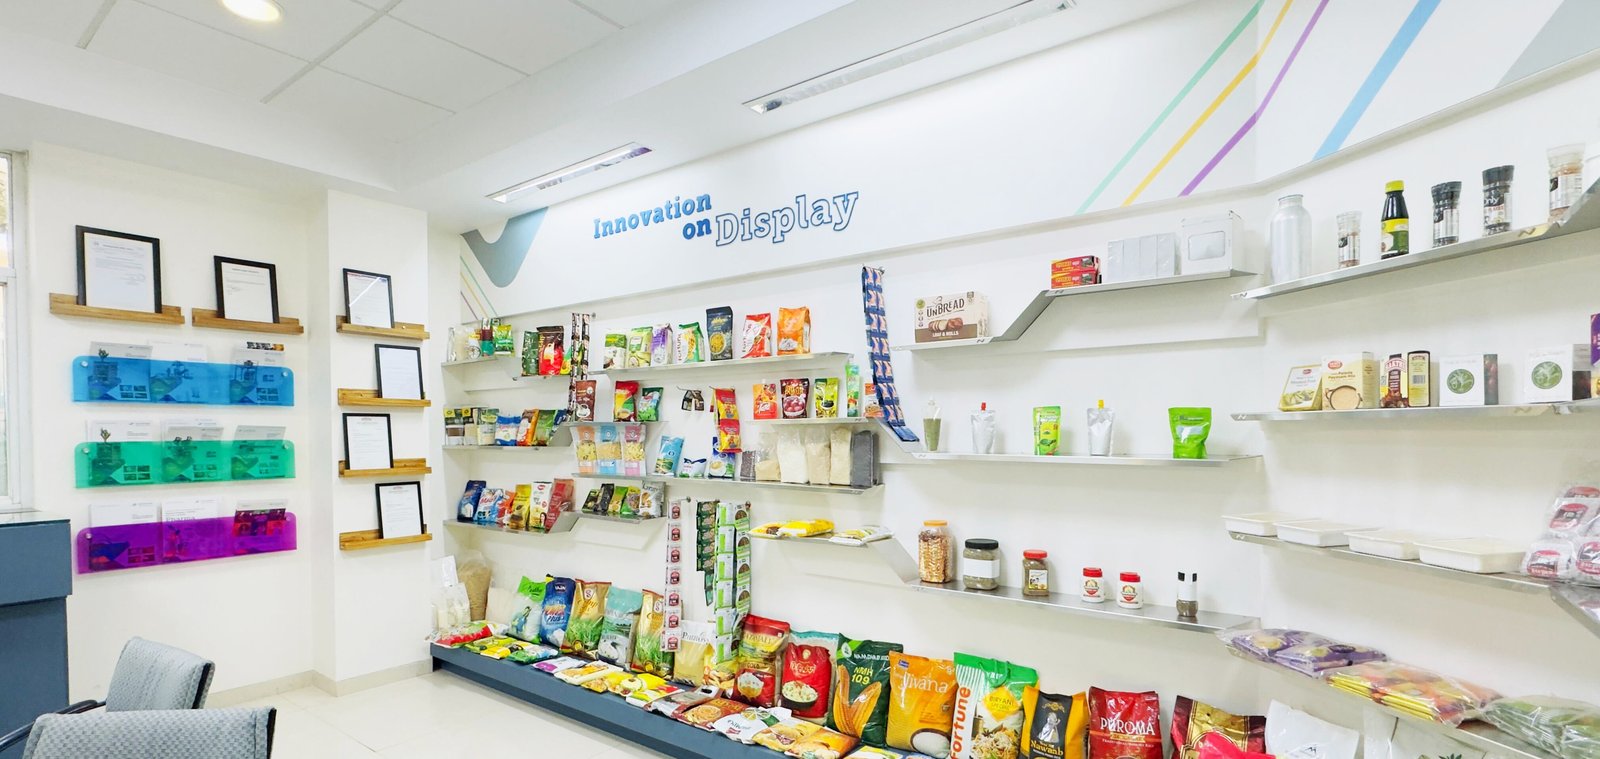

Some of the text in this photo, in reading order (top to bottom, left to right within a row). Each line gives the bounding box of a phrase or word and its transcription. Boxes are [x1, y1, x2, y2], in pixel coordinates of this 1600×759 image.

[593, 193, 712, 239] Innovation
[682, 191, 859, 247] on Display
[851, 673, 870, 685] 109
[1100, 717, 1156, 736] PUROMA
